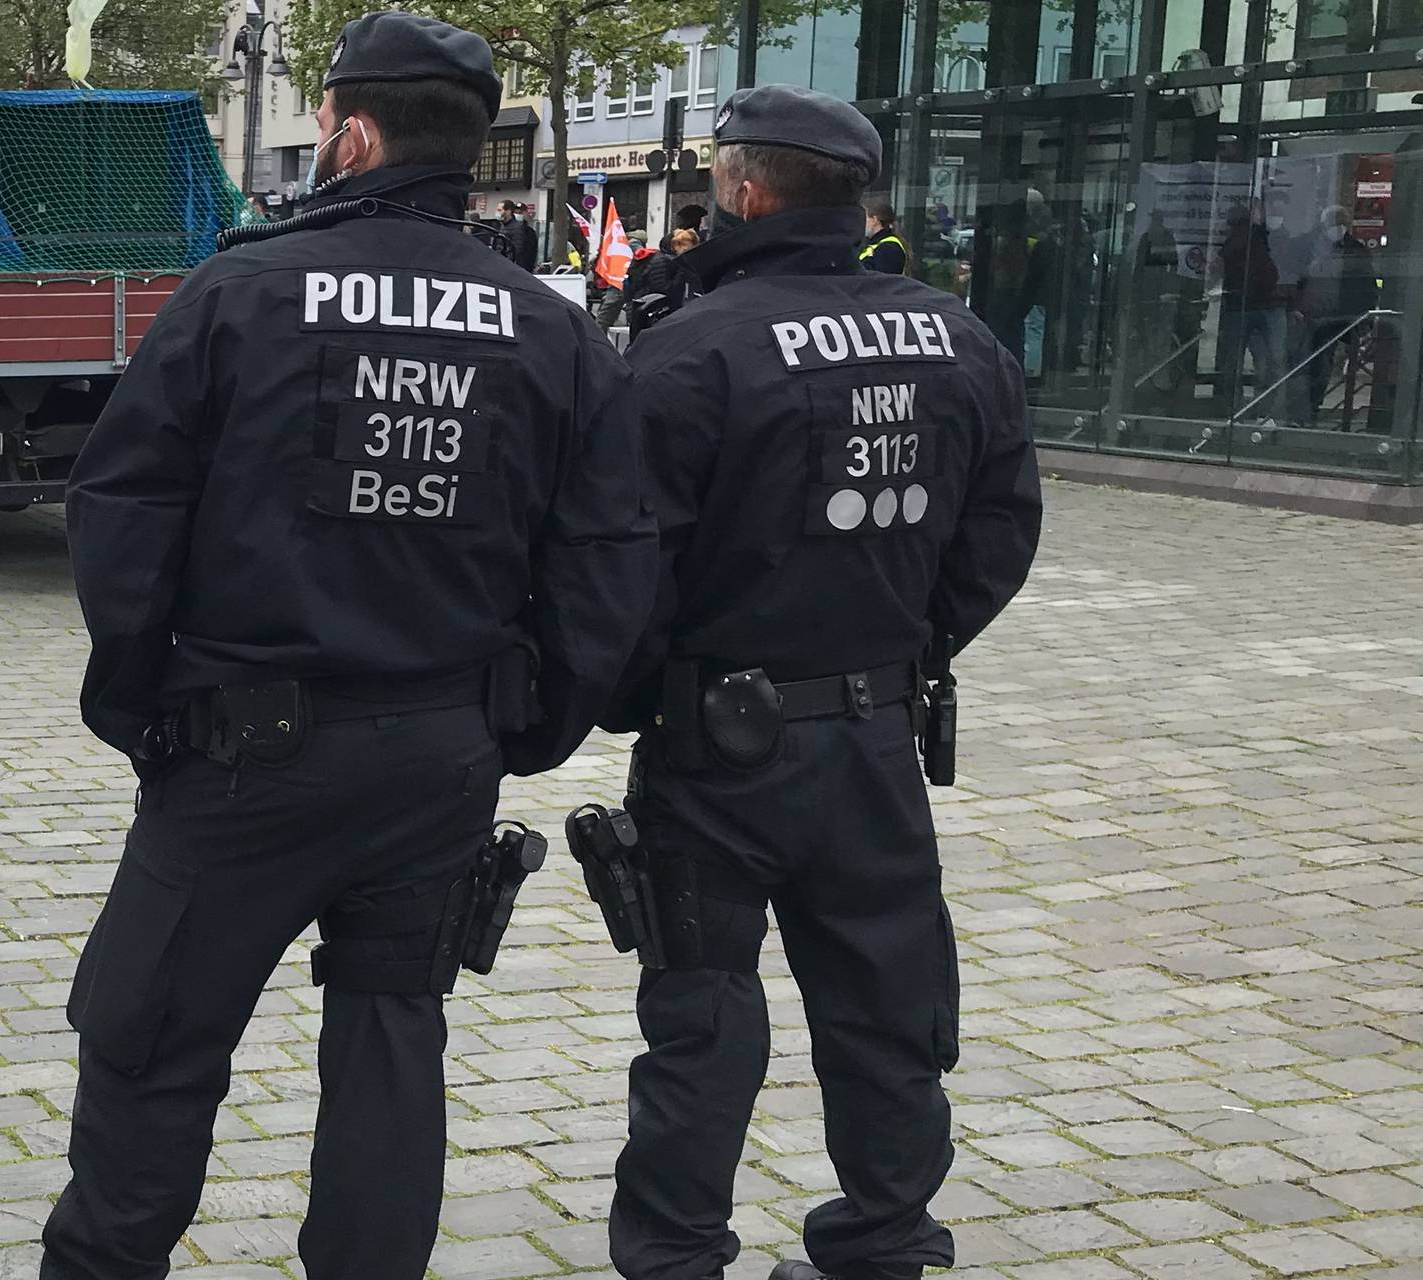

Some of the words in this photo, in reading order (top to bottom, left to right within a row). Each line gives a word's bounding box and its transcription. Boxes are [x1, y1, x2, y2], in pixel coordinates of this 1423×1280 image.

[304, 272, 515, 338] POLIZEI
[771, 312, 956, 367] POLIZEI
[355, 355, 476, 409] NRW
[851, 383, 916, 426] NRW
[364, 412, 463, 464] 3113
[845, 433, 919, 478] 3113
[349, 469, 459, 518] BeSi
